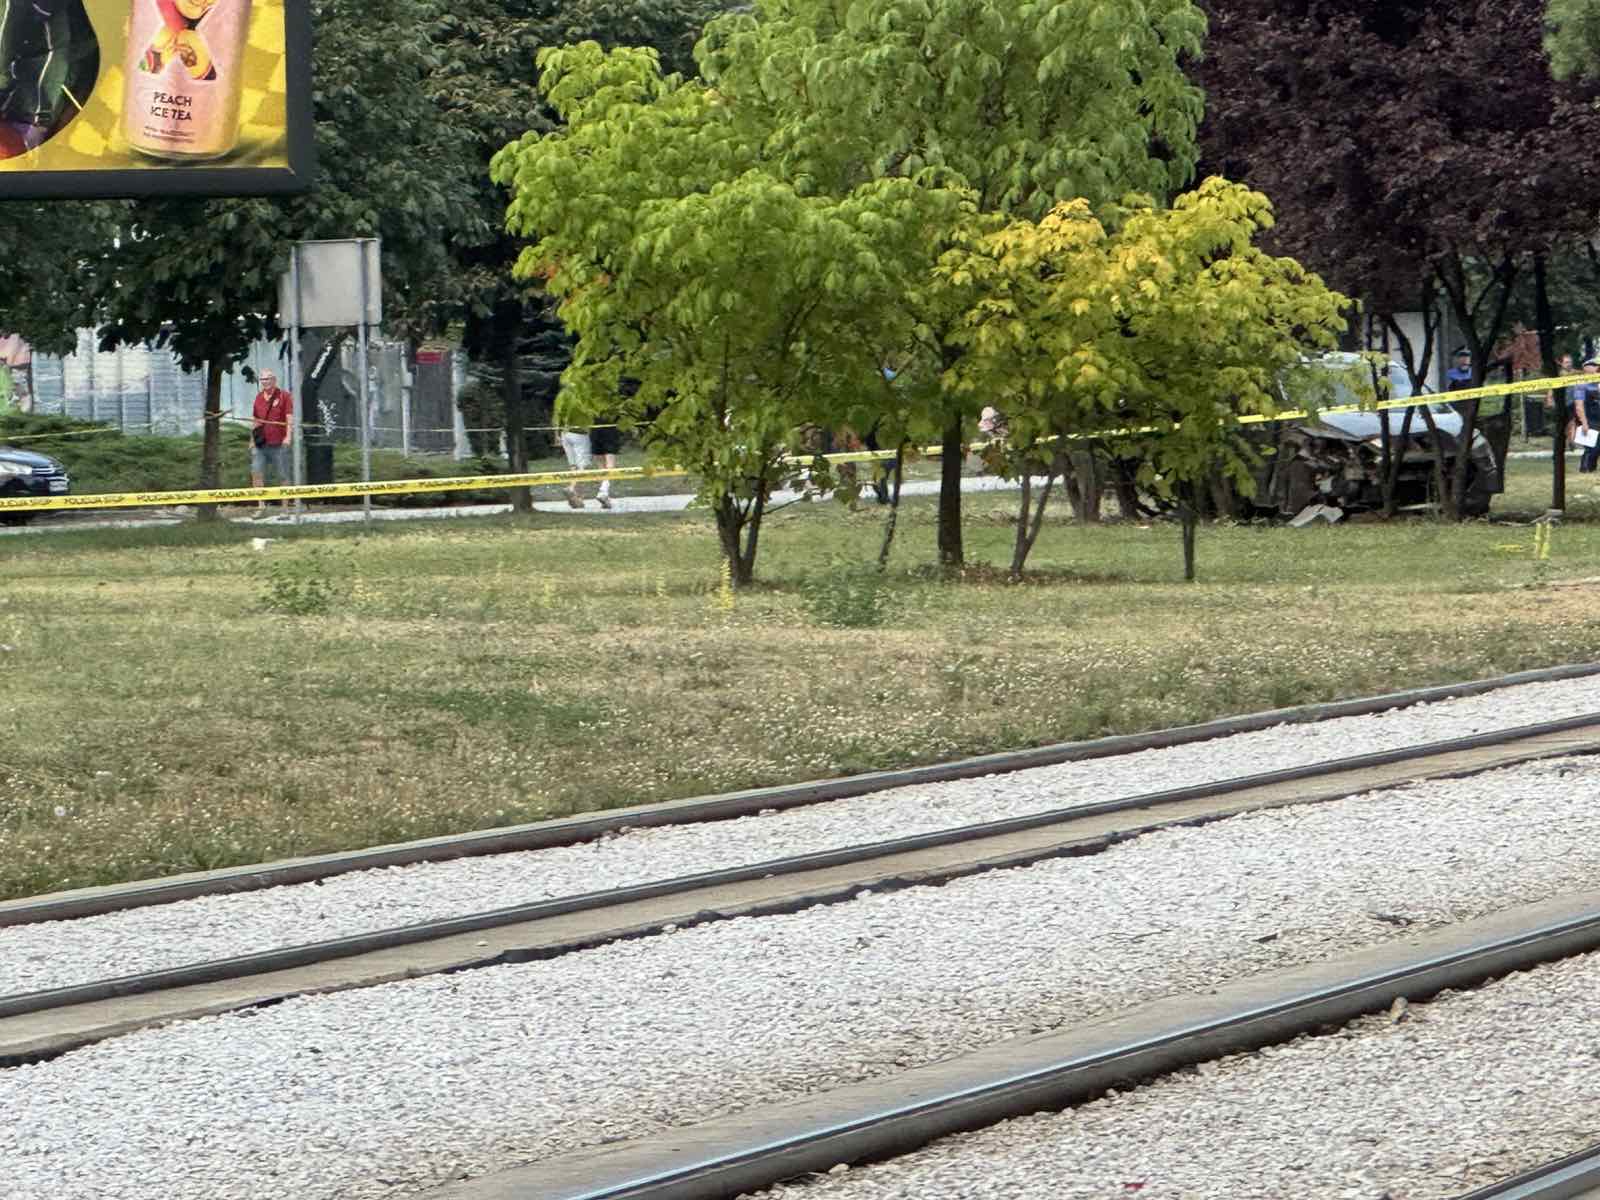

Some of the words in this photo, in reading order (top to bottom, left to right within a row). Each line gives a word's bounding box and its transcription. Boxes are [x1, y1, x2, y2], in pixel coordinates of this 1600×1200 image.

[153, 91, 192, 107] PEACH
[151, 106, 169, 118] ICE
[171, 108, 193, 121] TEA
